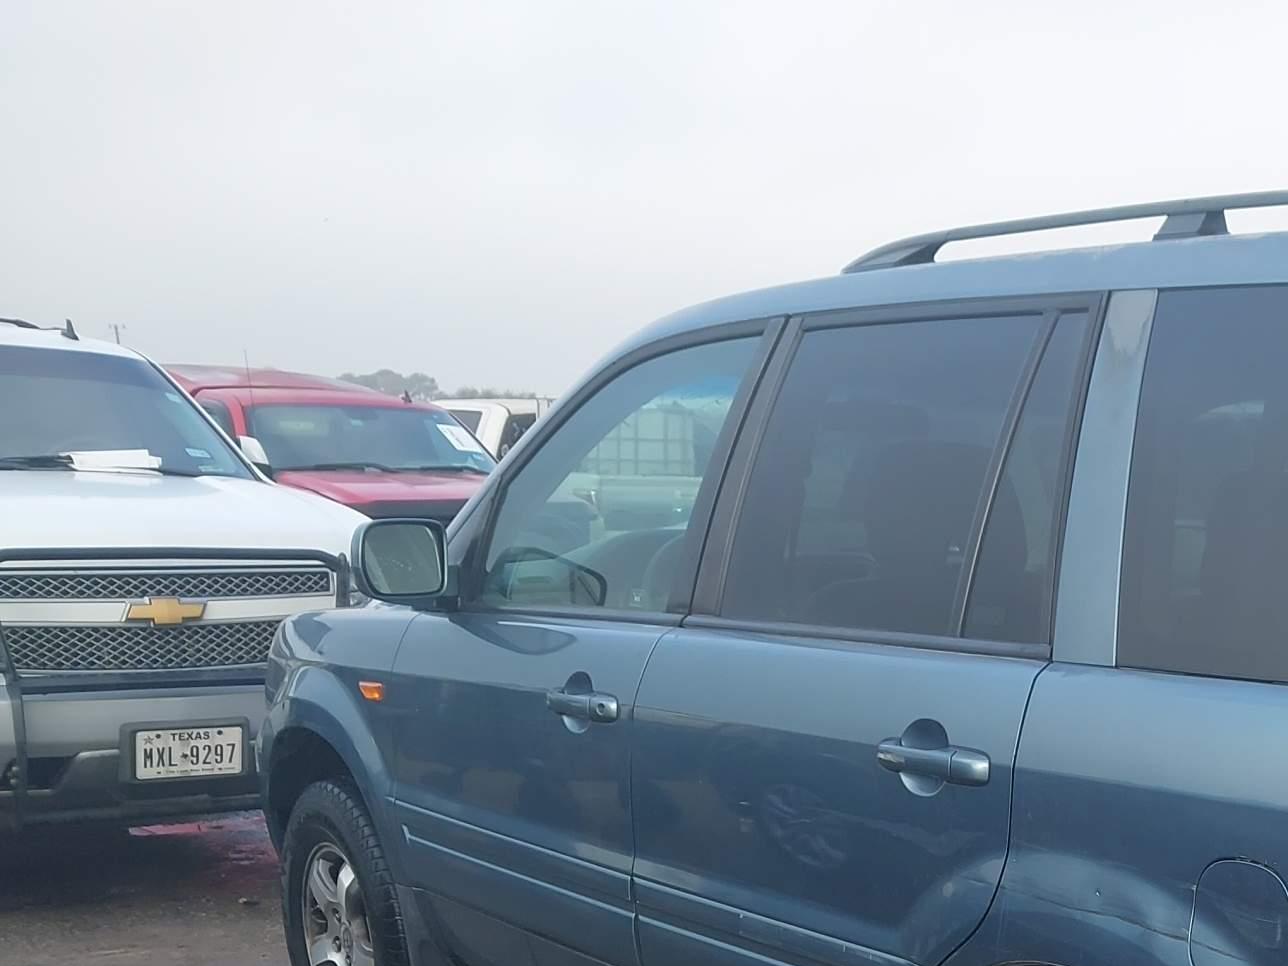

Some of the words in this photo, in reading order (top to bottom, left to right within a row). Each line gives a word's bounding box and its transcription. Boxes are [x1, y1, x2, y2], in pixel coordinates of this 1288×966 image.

[170, 731, 210, 742] TEXAS
[143, 746, 178, 768] MXL
[190, 743, 236, 765] 9297
